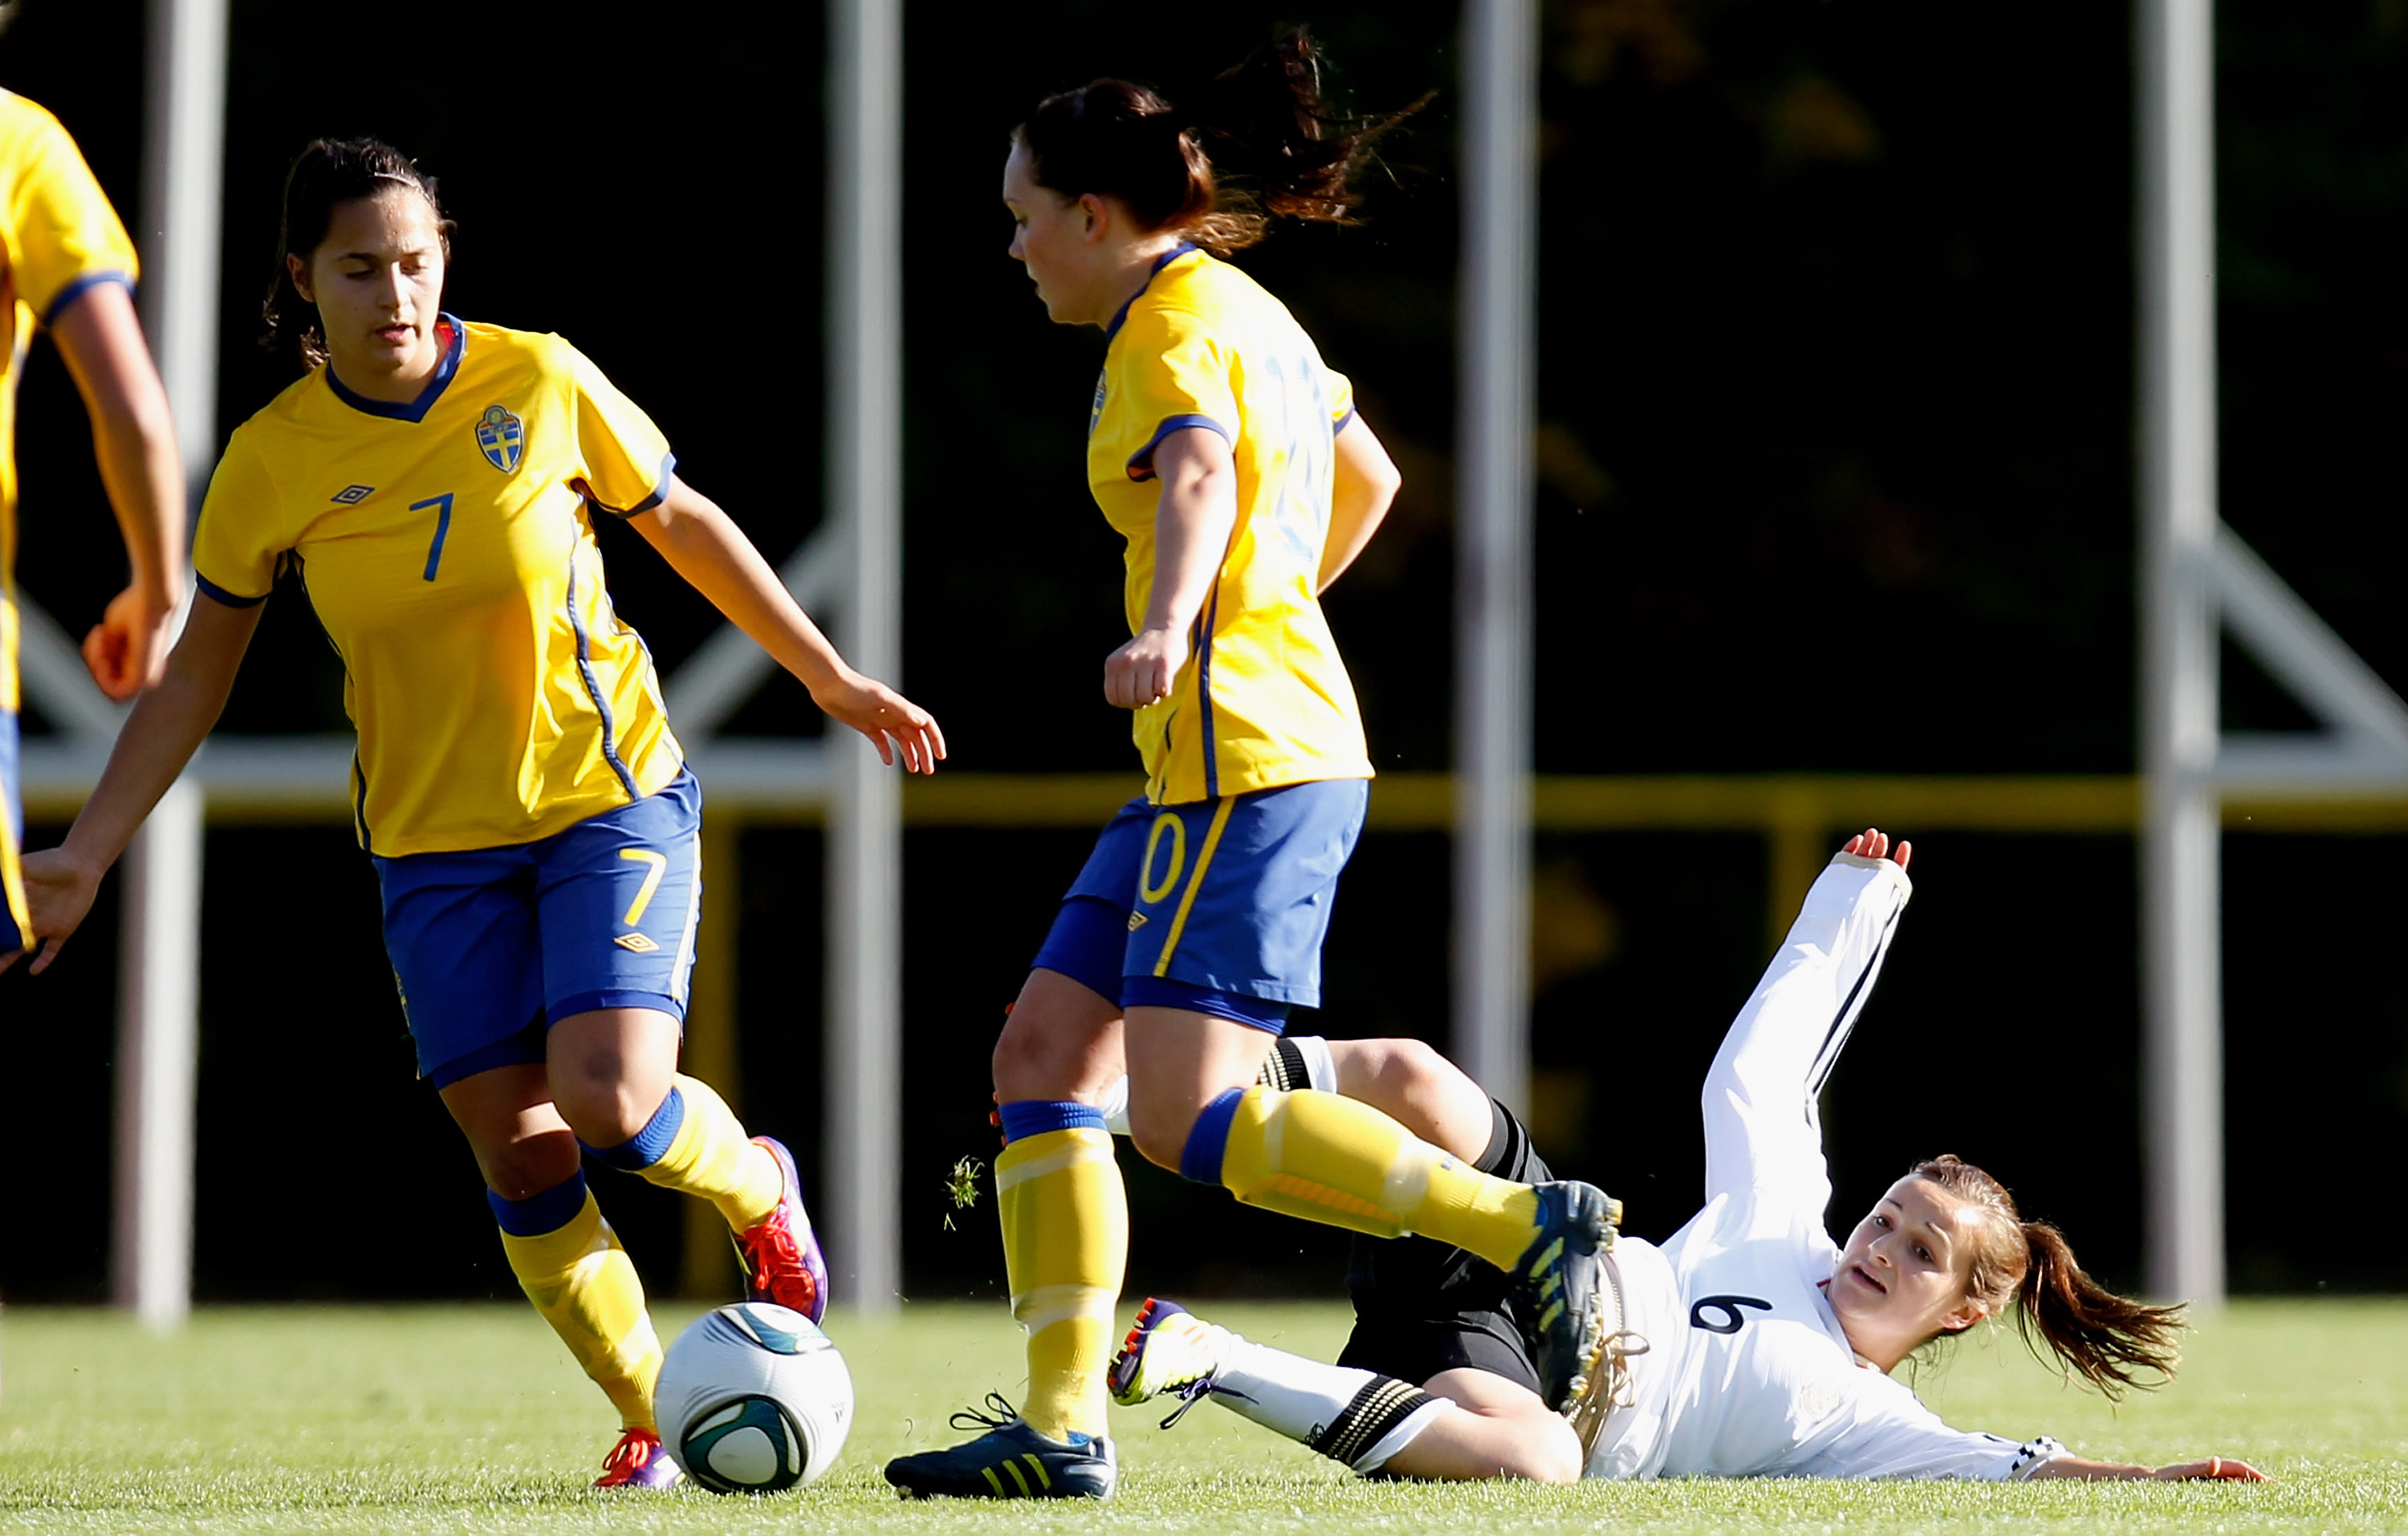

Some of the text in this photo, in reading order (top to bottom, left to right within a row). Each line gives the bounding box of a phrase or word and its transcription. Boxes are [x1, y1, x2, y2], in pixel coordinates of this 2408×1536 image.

[409, 492, 454, 582] 7
[618, 847, 668, 927] 7
[1690, 1294, 1774, 1335] 6
